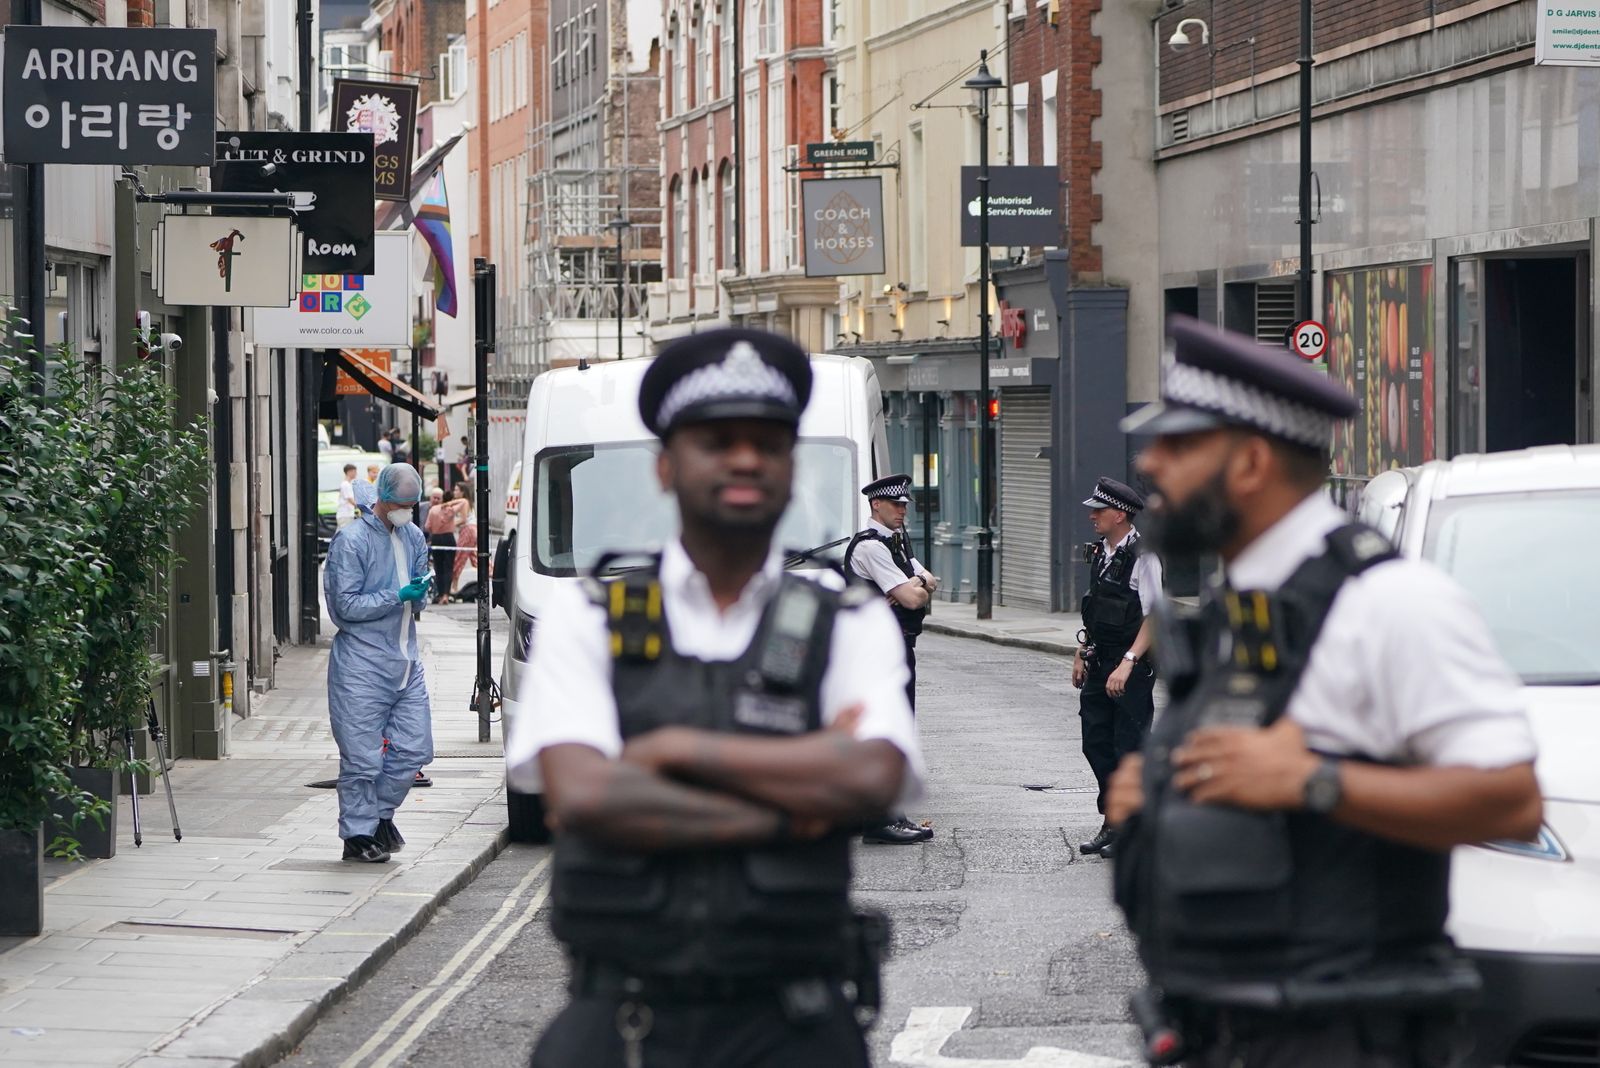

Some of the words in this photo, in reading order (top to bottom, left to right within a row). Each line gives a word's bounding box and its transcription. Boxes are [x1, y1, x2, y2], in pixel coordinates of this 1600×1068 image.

[1556, 9, 1563, 17] G
[1565, 10, 1597, 18] JARVIS
[22, 48, 197, 82] ARIRANG
[25, 101, 191, 150] 아리랑
[273, 148, 288, 164] &
[292, 150, 366, 163] GRIND
[814, 149, 845, 158] GREENE
[847, 148, 868, 156] KING
[987, 196, 1032, 205] Authorised
[814, 207, 871, 221] COACH
[987, 207, 1017, 216] Service
[1018, 207, 1053, 216] Provider
[838, 223, 848, 235] &
[814, 236, 875, 250] HORSES
[300, 327, 364, 335] www.color.co.uk
[1299, 331, 1323, 348] 20
